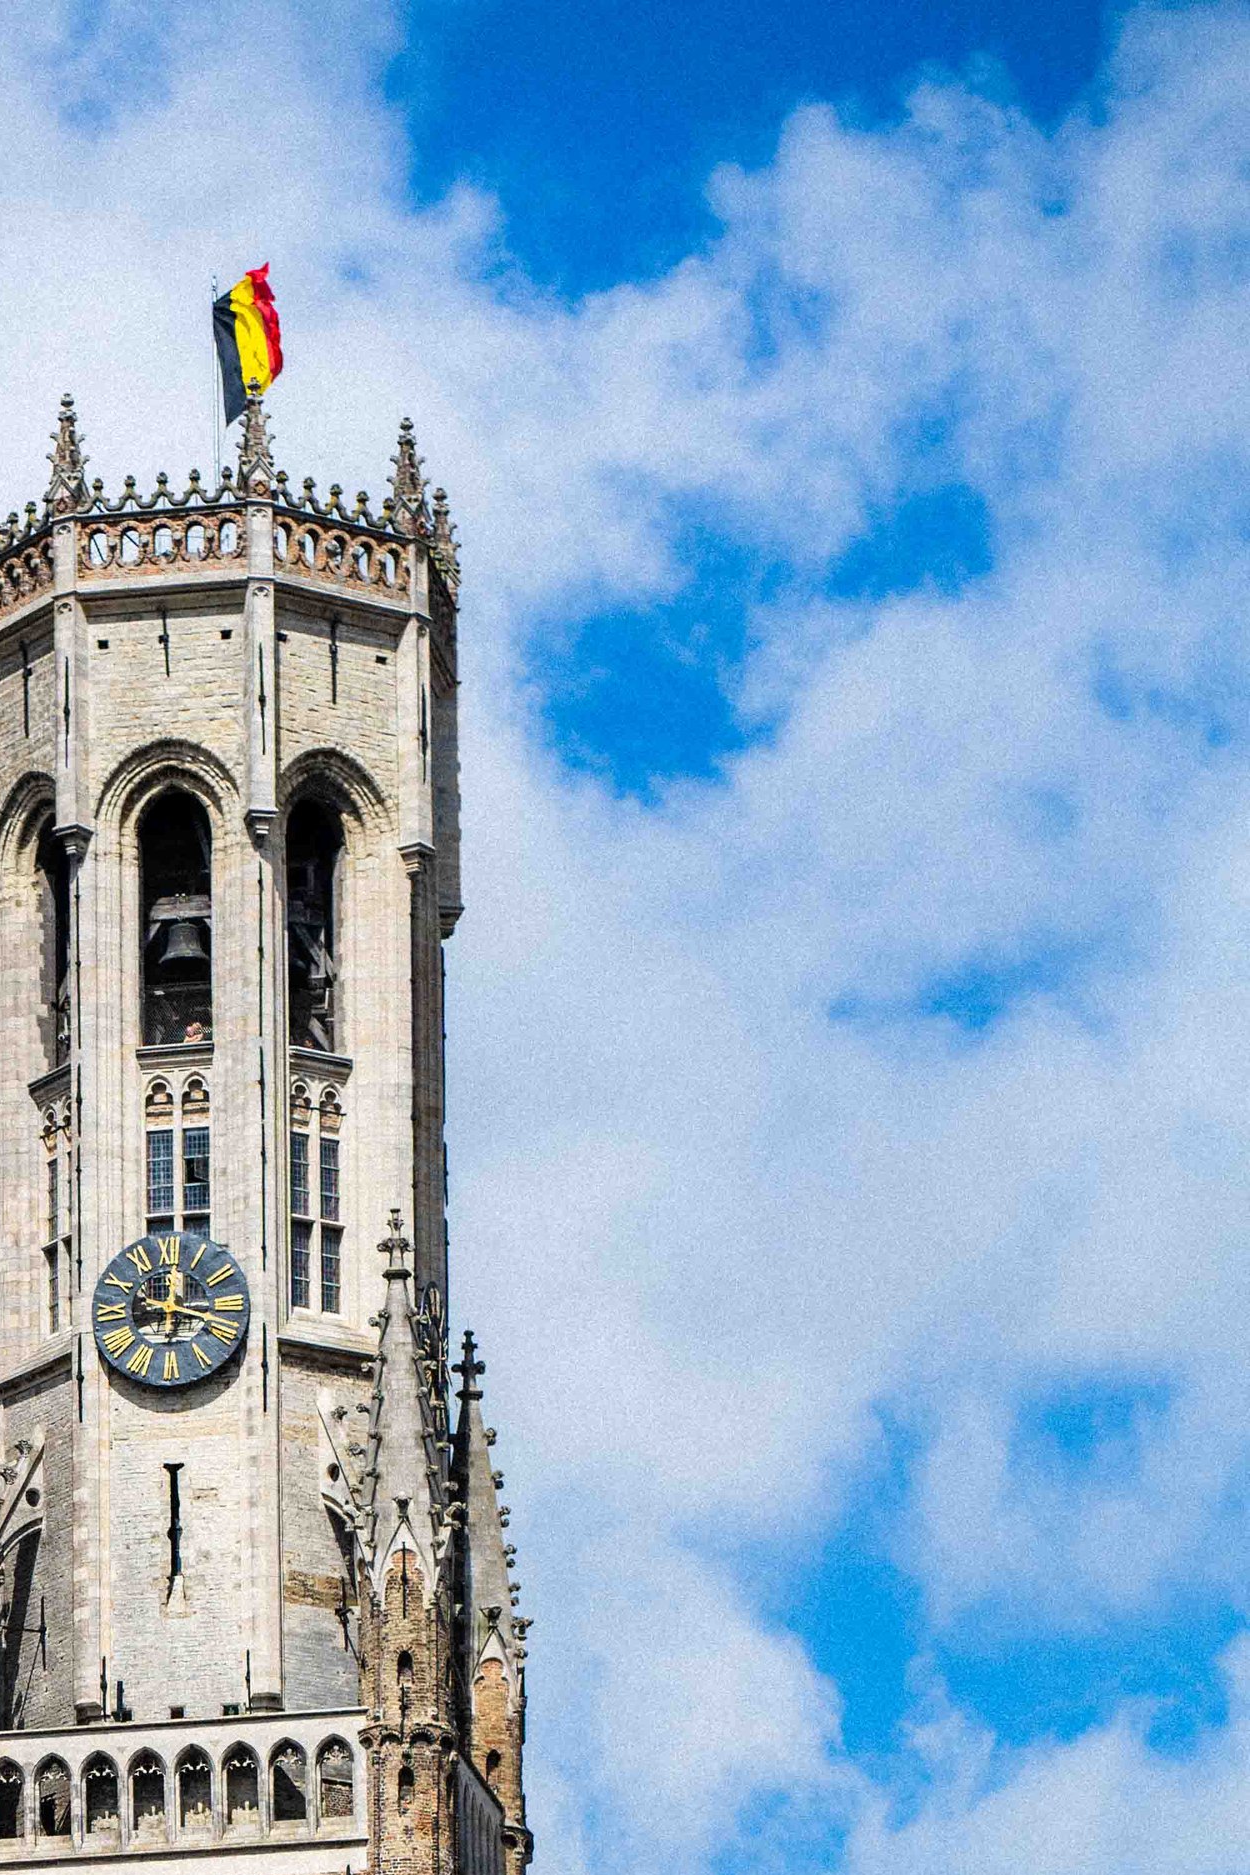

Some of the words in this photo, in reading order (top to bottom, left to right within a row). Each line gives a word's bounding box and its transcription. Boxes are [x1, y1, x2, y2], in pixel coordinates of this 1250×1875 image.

[126, 1245, 152, 1276] XI
[157, 1236, 180, 1266] XII
[191, 1243, 207, 1269] I
[104, 1272, 133, 1294] X
[206, 1263, 235, 1287] II
[214, 1294, 244, 1311] III
[102, 1326, 135, 1359] VIII
[192, 1342, 212, 1369] V
[126, 1344, 154, 1377] VII
[163, 1351, 180, 1381] VI
